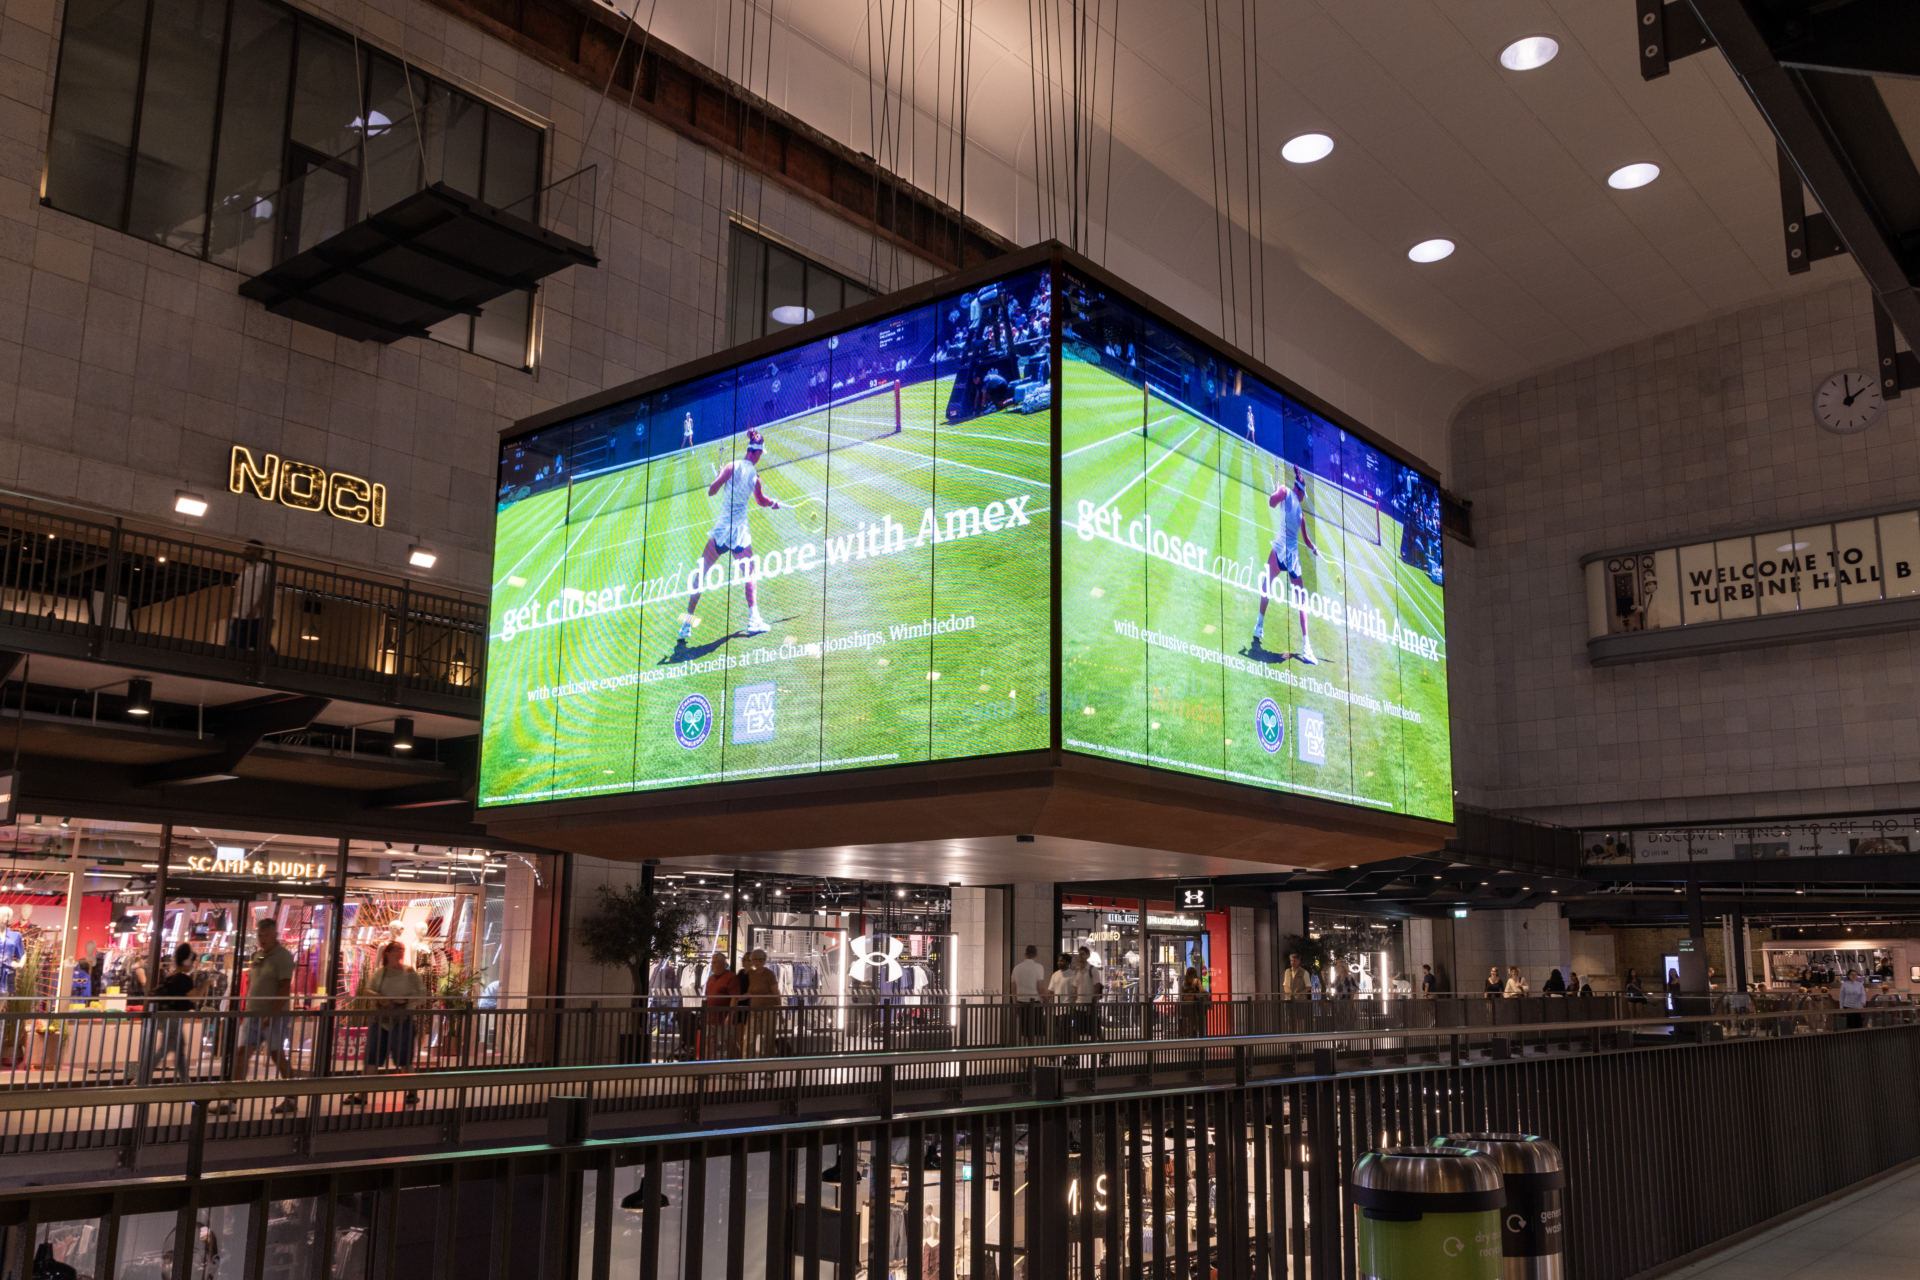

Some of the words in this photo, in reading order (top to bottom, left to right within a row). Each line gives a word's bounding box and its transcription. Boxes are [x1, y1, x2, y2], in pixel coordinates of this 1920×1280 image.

[229, 445, 386, 527] NOCI
[501, 598, 541, 641] get
[546, 583, 626, 624] closer
[630, 562, 684, 607] and
[687, 556, 724, 594] do
[732, 543, 816, 586] more
[826, 514, 905, 565] with
[914, 494, 1031, 547] Amex
[1076, 499, 1122, 541] get
[1129, 514, 1208, 574] closer
[1213, 556, 1254, 590] and
[1258, 563, 1285, 603] do
[1290, 583, 1341, 625] more
[1347, 604, 1388, 642] with
[1391, 617, 1439, 662] Amex
[1689, 554, 1816, 587] WELCOME
[1827, 547, 1863, 567] TO
[1690, 578, 1801, 605] TURBINE
[1812, 565, 1880, 589] HALL
[1896, 561, 1911, 578] B
[527, 684, 550, 702] with
[551, 678, 598, 698] exclusive
[600, 665, 664, 693] experiences
[666, 660, 688, 679] and
[690, 653, 737, 676] benefits
[739, 652, 751, 667] at
[753, 646, 777, 664] The
[889, 614, 975, 641] Wimbledon
[1113, 619, 1139, 639] with
[1141, 629, 1189, 654] exclusive
[1190, 644, 1245, 671] experiences
[1246, 661, 1264, 677] and
[1264, 662, 1298, 687] benefits
[1299, 676, 1307, 690] at
[1308, 677, 1323, 694] The
[1383, 700, 1421, 723] Wimbledon
[1648, 829, 1725, 843] DISCOVER
[1799, 823, 1821, 836] TO
[188, 855, 251, 873] SCAMP
[252, 860, 266, 874] &
[267, 861, 316, 877] DUDE
[1822, 954, 1866, 964] GRIND
[1475, 1231, 1491, 1245] dry
